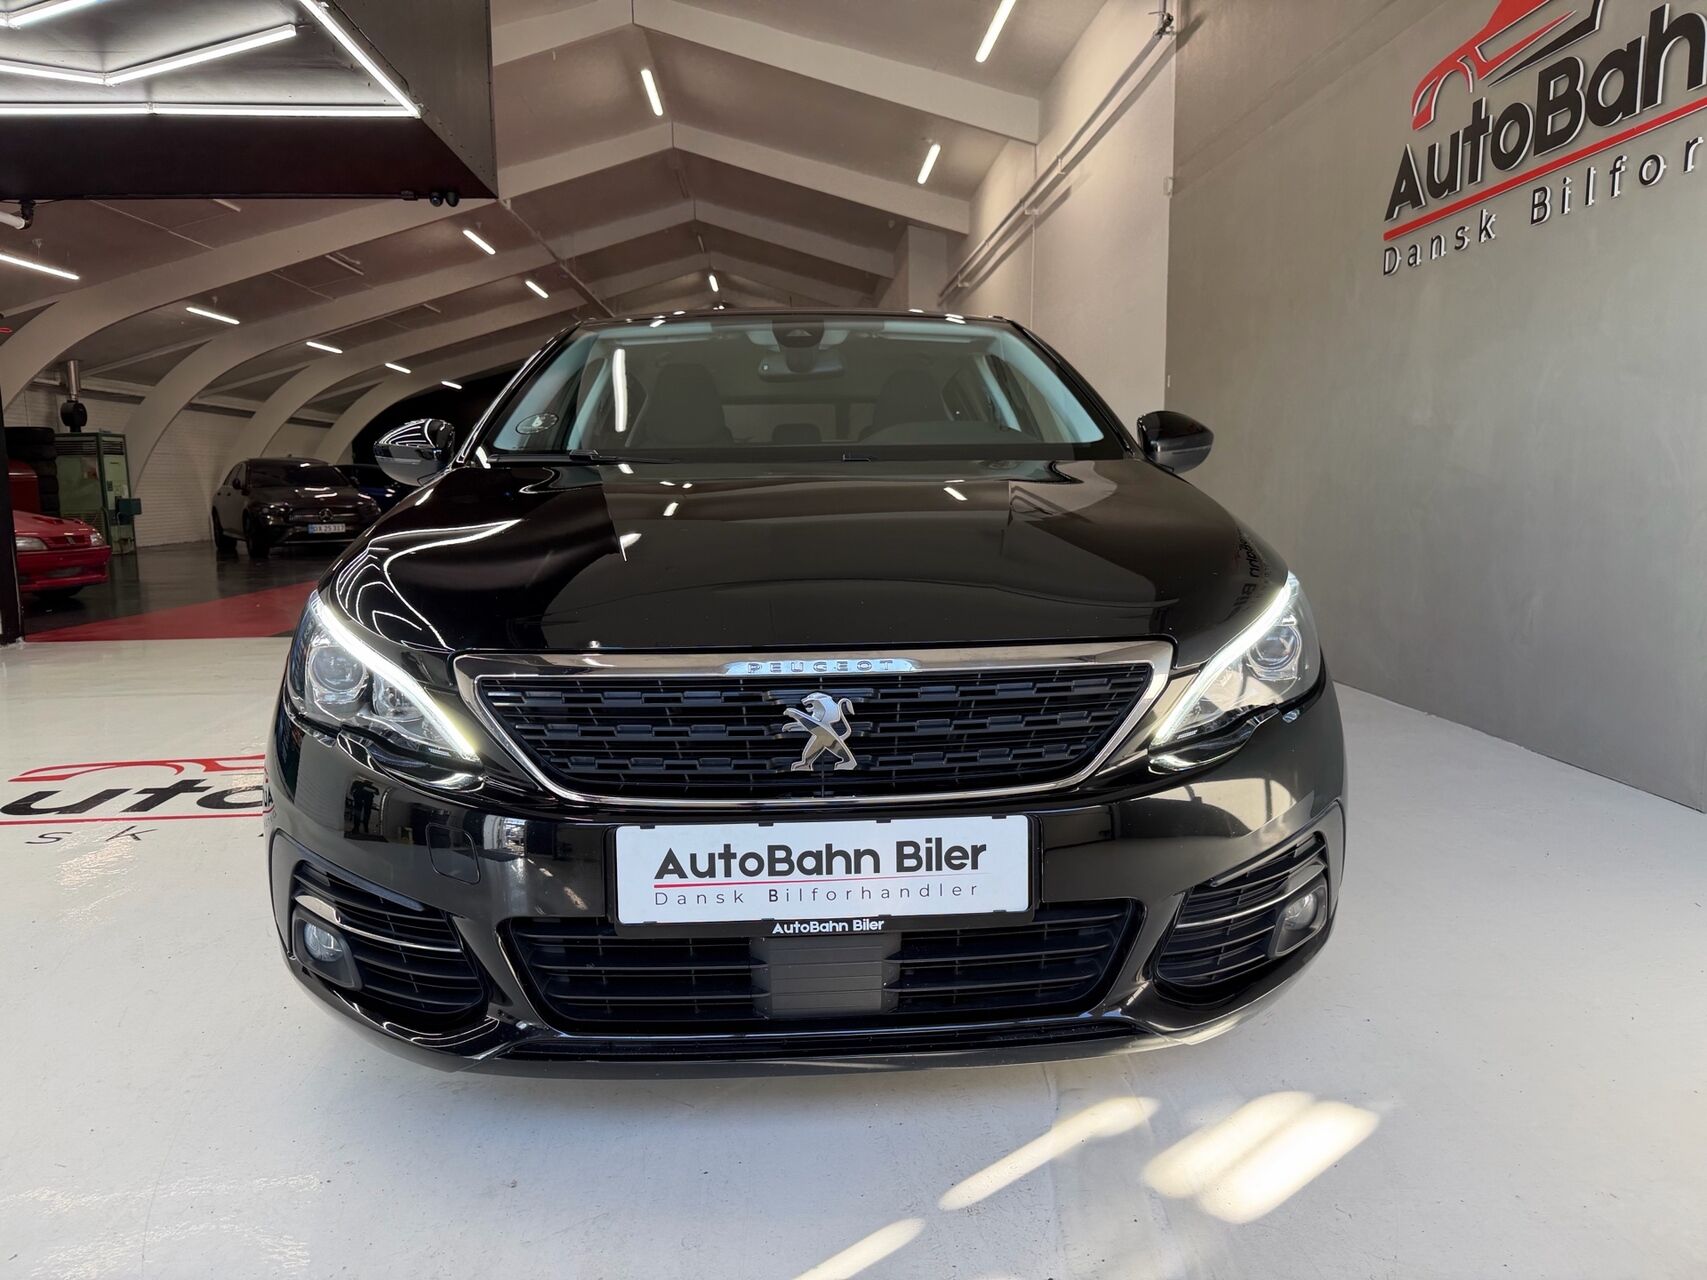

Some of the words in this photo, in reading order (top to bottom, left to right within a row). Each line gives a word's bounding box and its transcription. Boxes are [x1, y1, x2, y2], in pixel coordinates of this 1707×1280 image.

[1384, 3, 1707, 222] AutoBah
[1383, 209, 1497, 276] Dansk
[1530, 136, 1704, 225] Bilfor
[747, 660, 893, 674] PEUGEOT
[654, 843, 881, 880] AutoBahn
[895, 837, 987, 873] Biler
[655, 890, 745, 906] Dansk
[768, 882, 978, 903] Bilforhandler
[772, 920, 849, 934] AutoBahn
[852, 918, 885, 932] Biler
